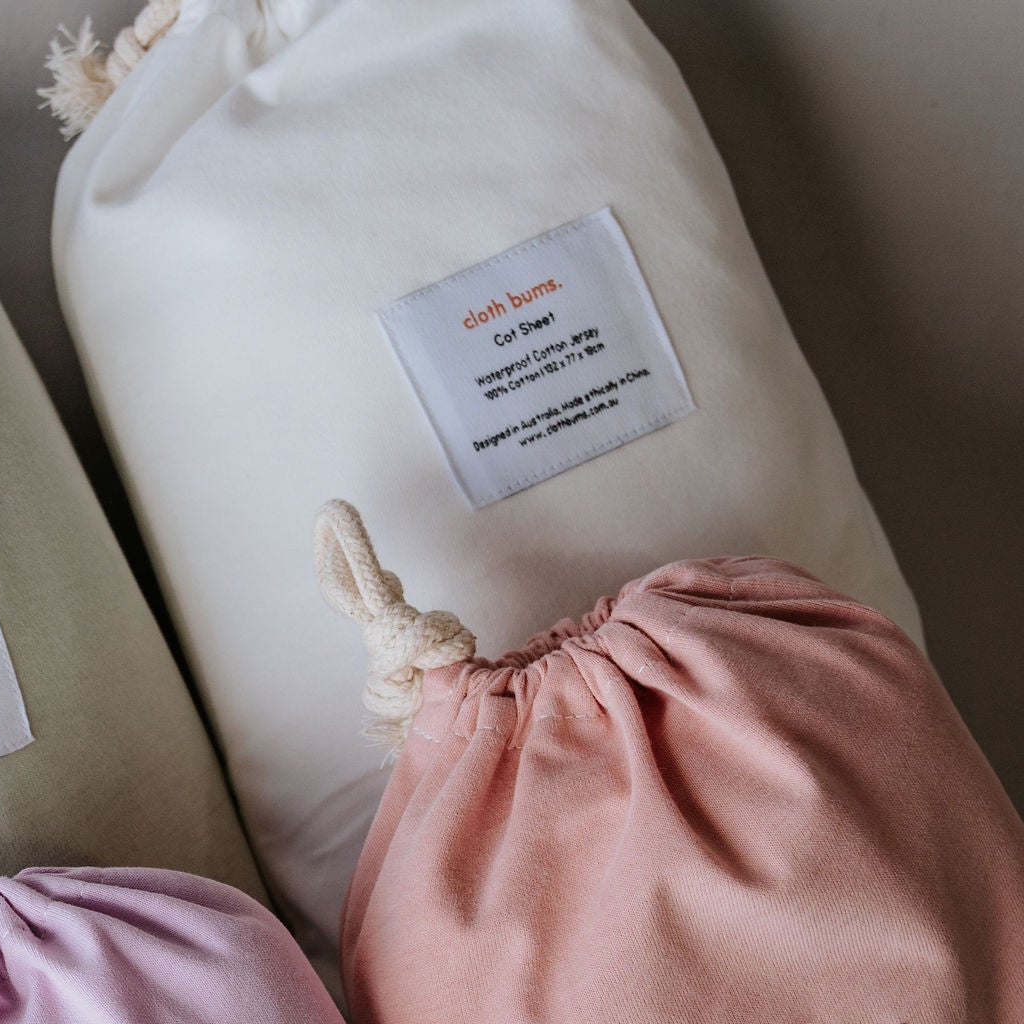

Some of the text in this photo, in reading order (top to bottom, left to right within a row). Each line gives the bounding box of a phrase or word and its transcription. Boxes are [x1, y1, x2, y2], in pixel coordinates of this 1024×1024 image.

[463, 278, 562, 329] cloth bums.
[493, 311, 555, 347] Cot Sheet
[474, 327, 599, 387] Waterproof Cotton Jersey
[483, 385, 509, 400] 100%
[507, 371, 541, 391] Cotton
[542, 360, 559, 374] 132
[564, 352, 576, 364] 77
[472, 427, 512, 452] Designed
[511, 425, 520, 434] in
[561, 396, 584, 411] Made
[583, 380, 618, 402] ethically
[618, 377, 627, 385] in
